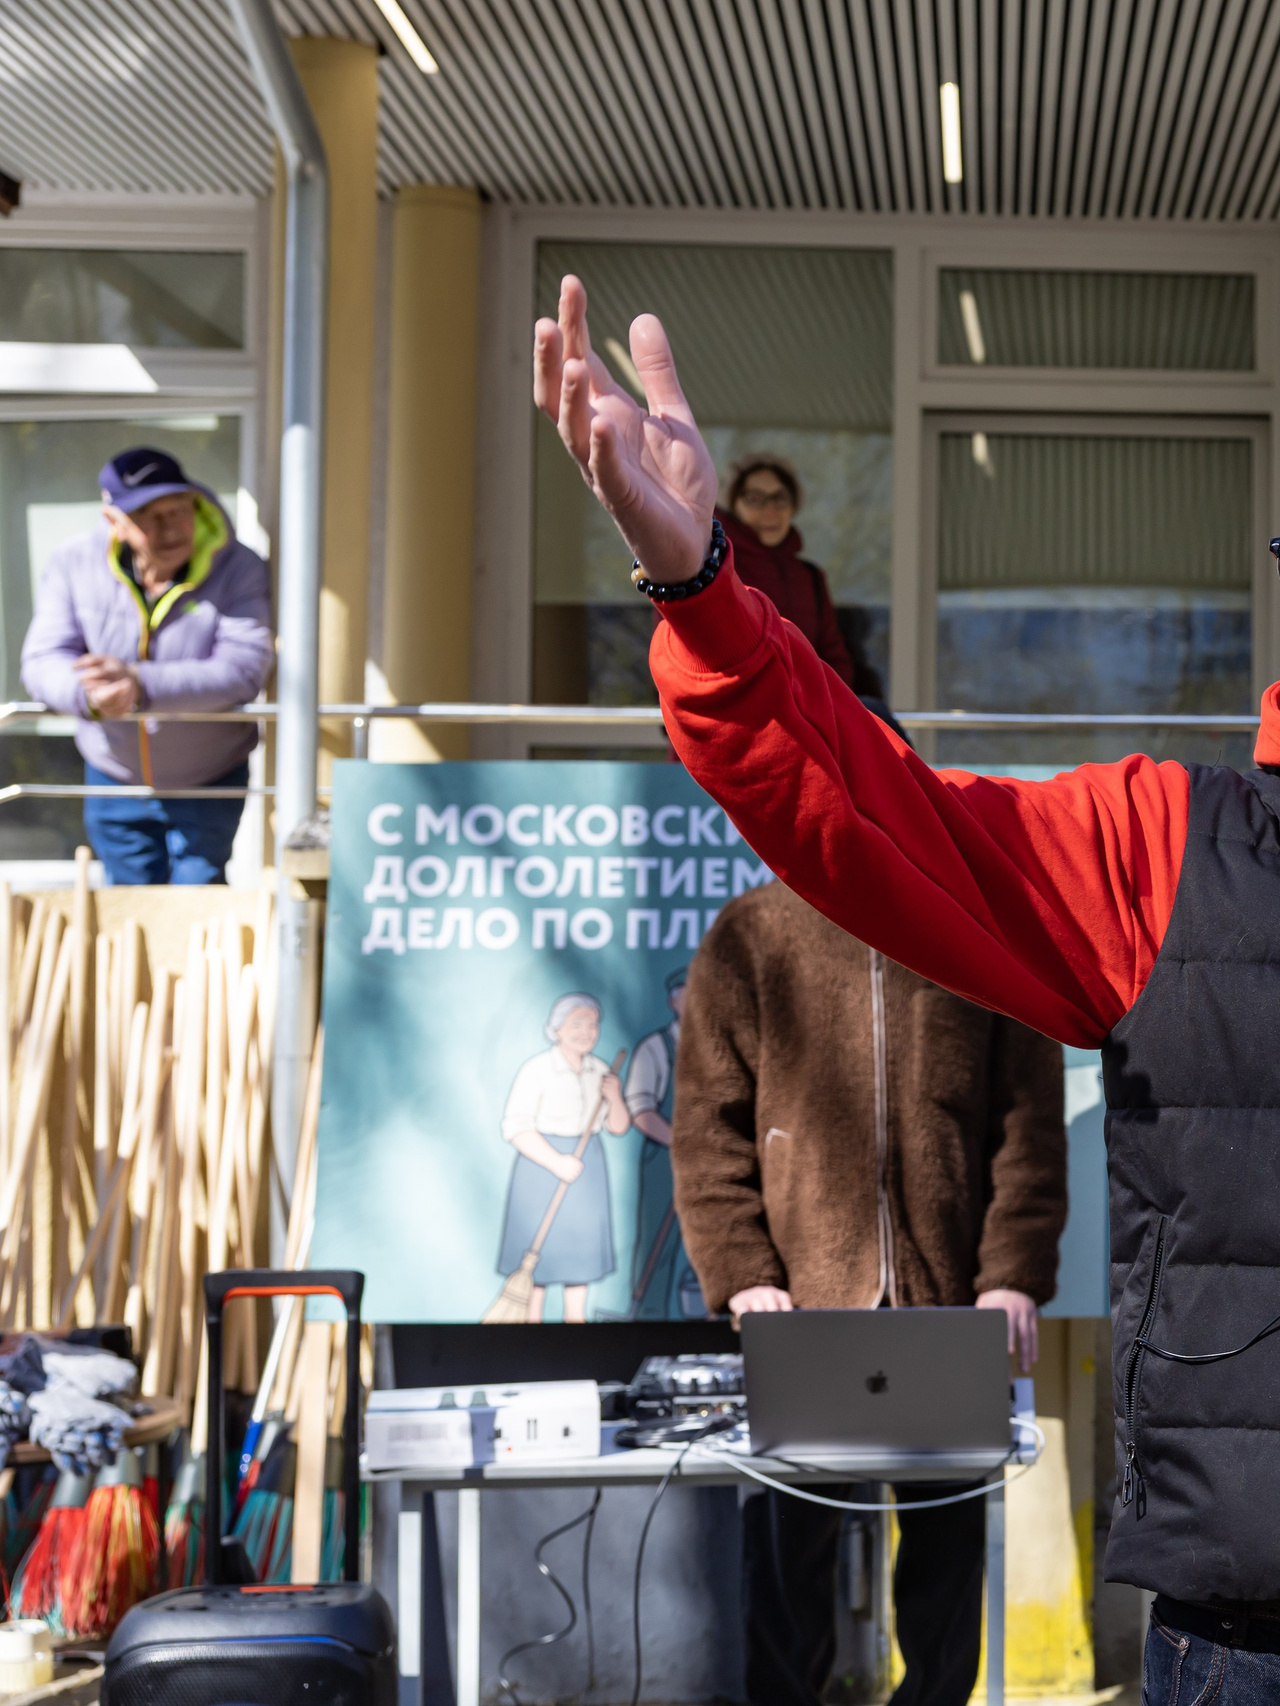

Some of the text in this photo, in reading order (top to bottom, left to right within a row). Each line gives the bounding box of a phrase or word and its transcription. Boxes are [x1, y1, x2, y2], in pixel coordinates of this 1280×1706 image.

[367, 804, 403, 845] С
[363, 856, 775, 902] ДОЛГОЛЕТИЕМ
[362, 908, 719, 955] ДЕЛО ПО ПЛ
